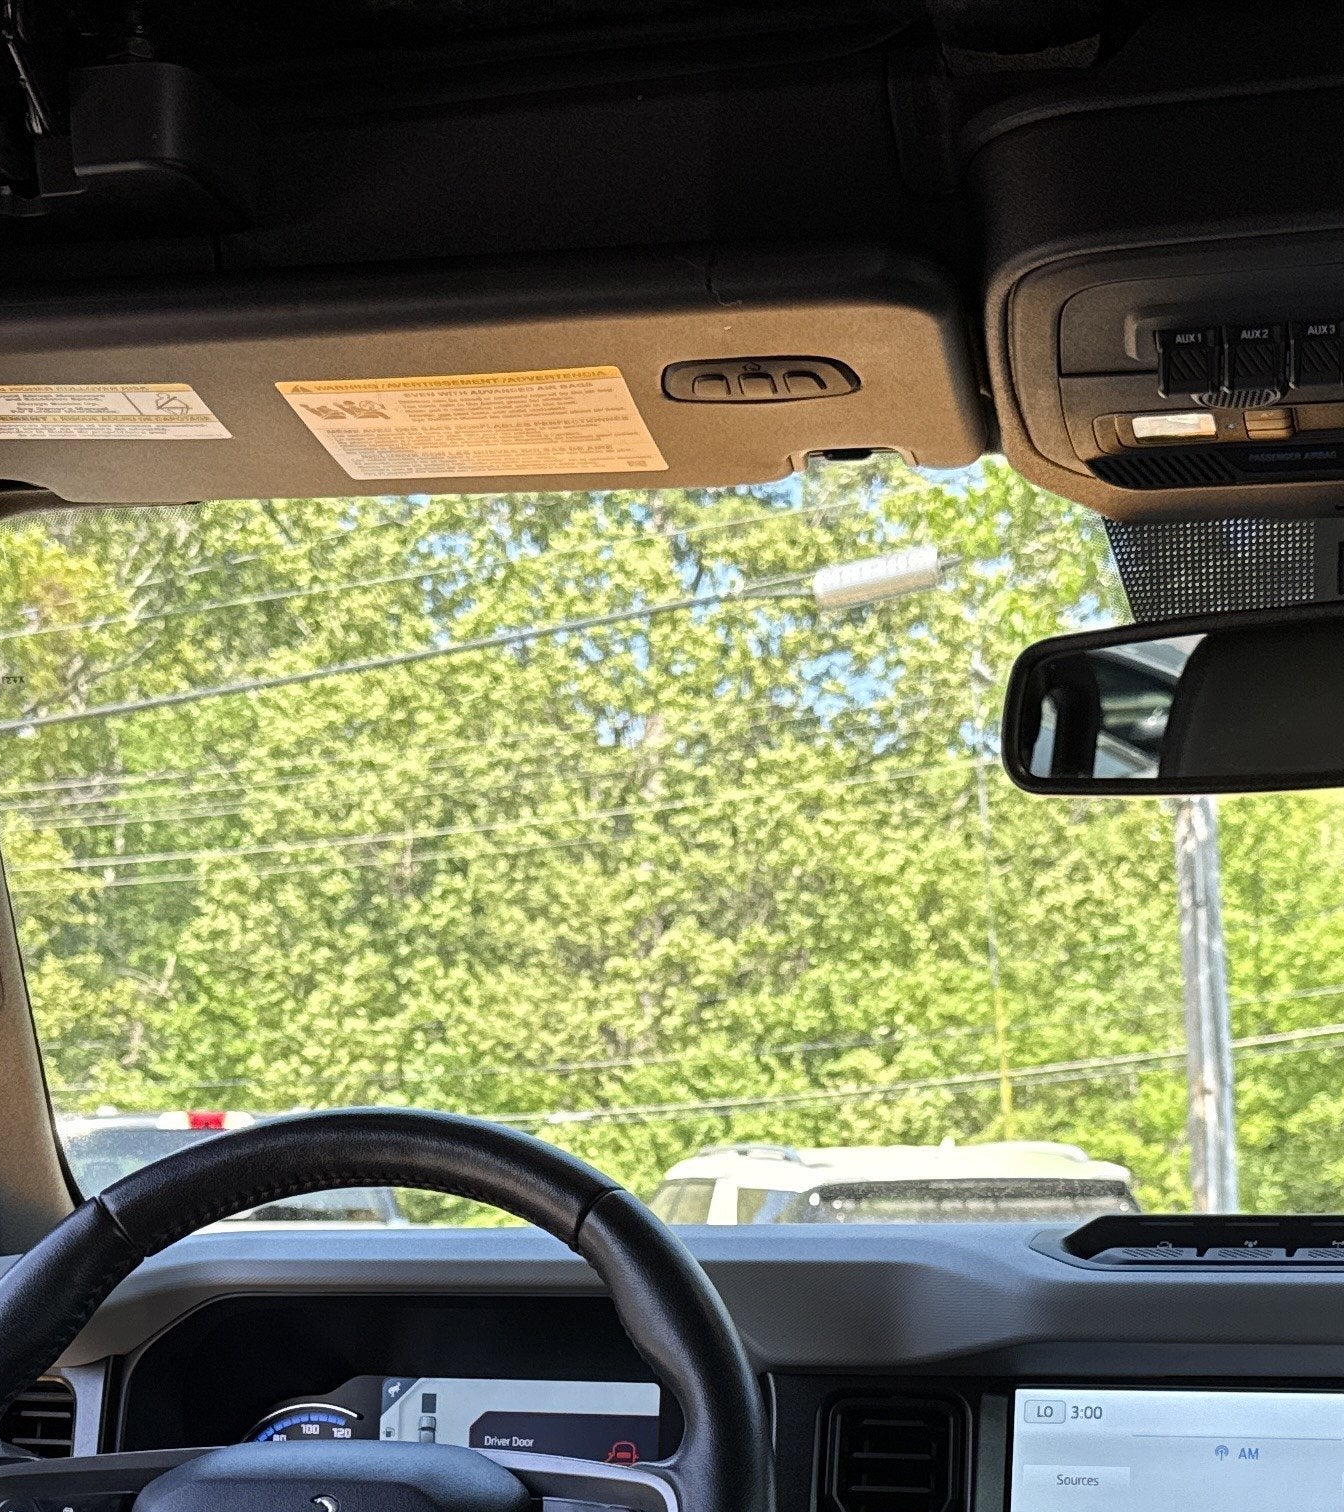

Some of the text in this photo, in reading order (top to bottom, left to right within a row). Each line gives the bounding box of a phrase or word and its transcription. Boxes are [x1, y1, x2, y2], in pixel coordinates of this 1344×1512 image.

[1036, 1405, 1103, 1420] LO 3:00
[301, 1424, 351, 1439] 100 120
[484, 1436, 534, 1448] Driver Door
[1238, 1447, 1259, 1460] AM
[1056, 1474, 1099, 1487] Sources
